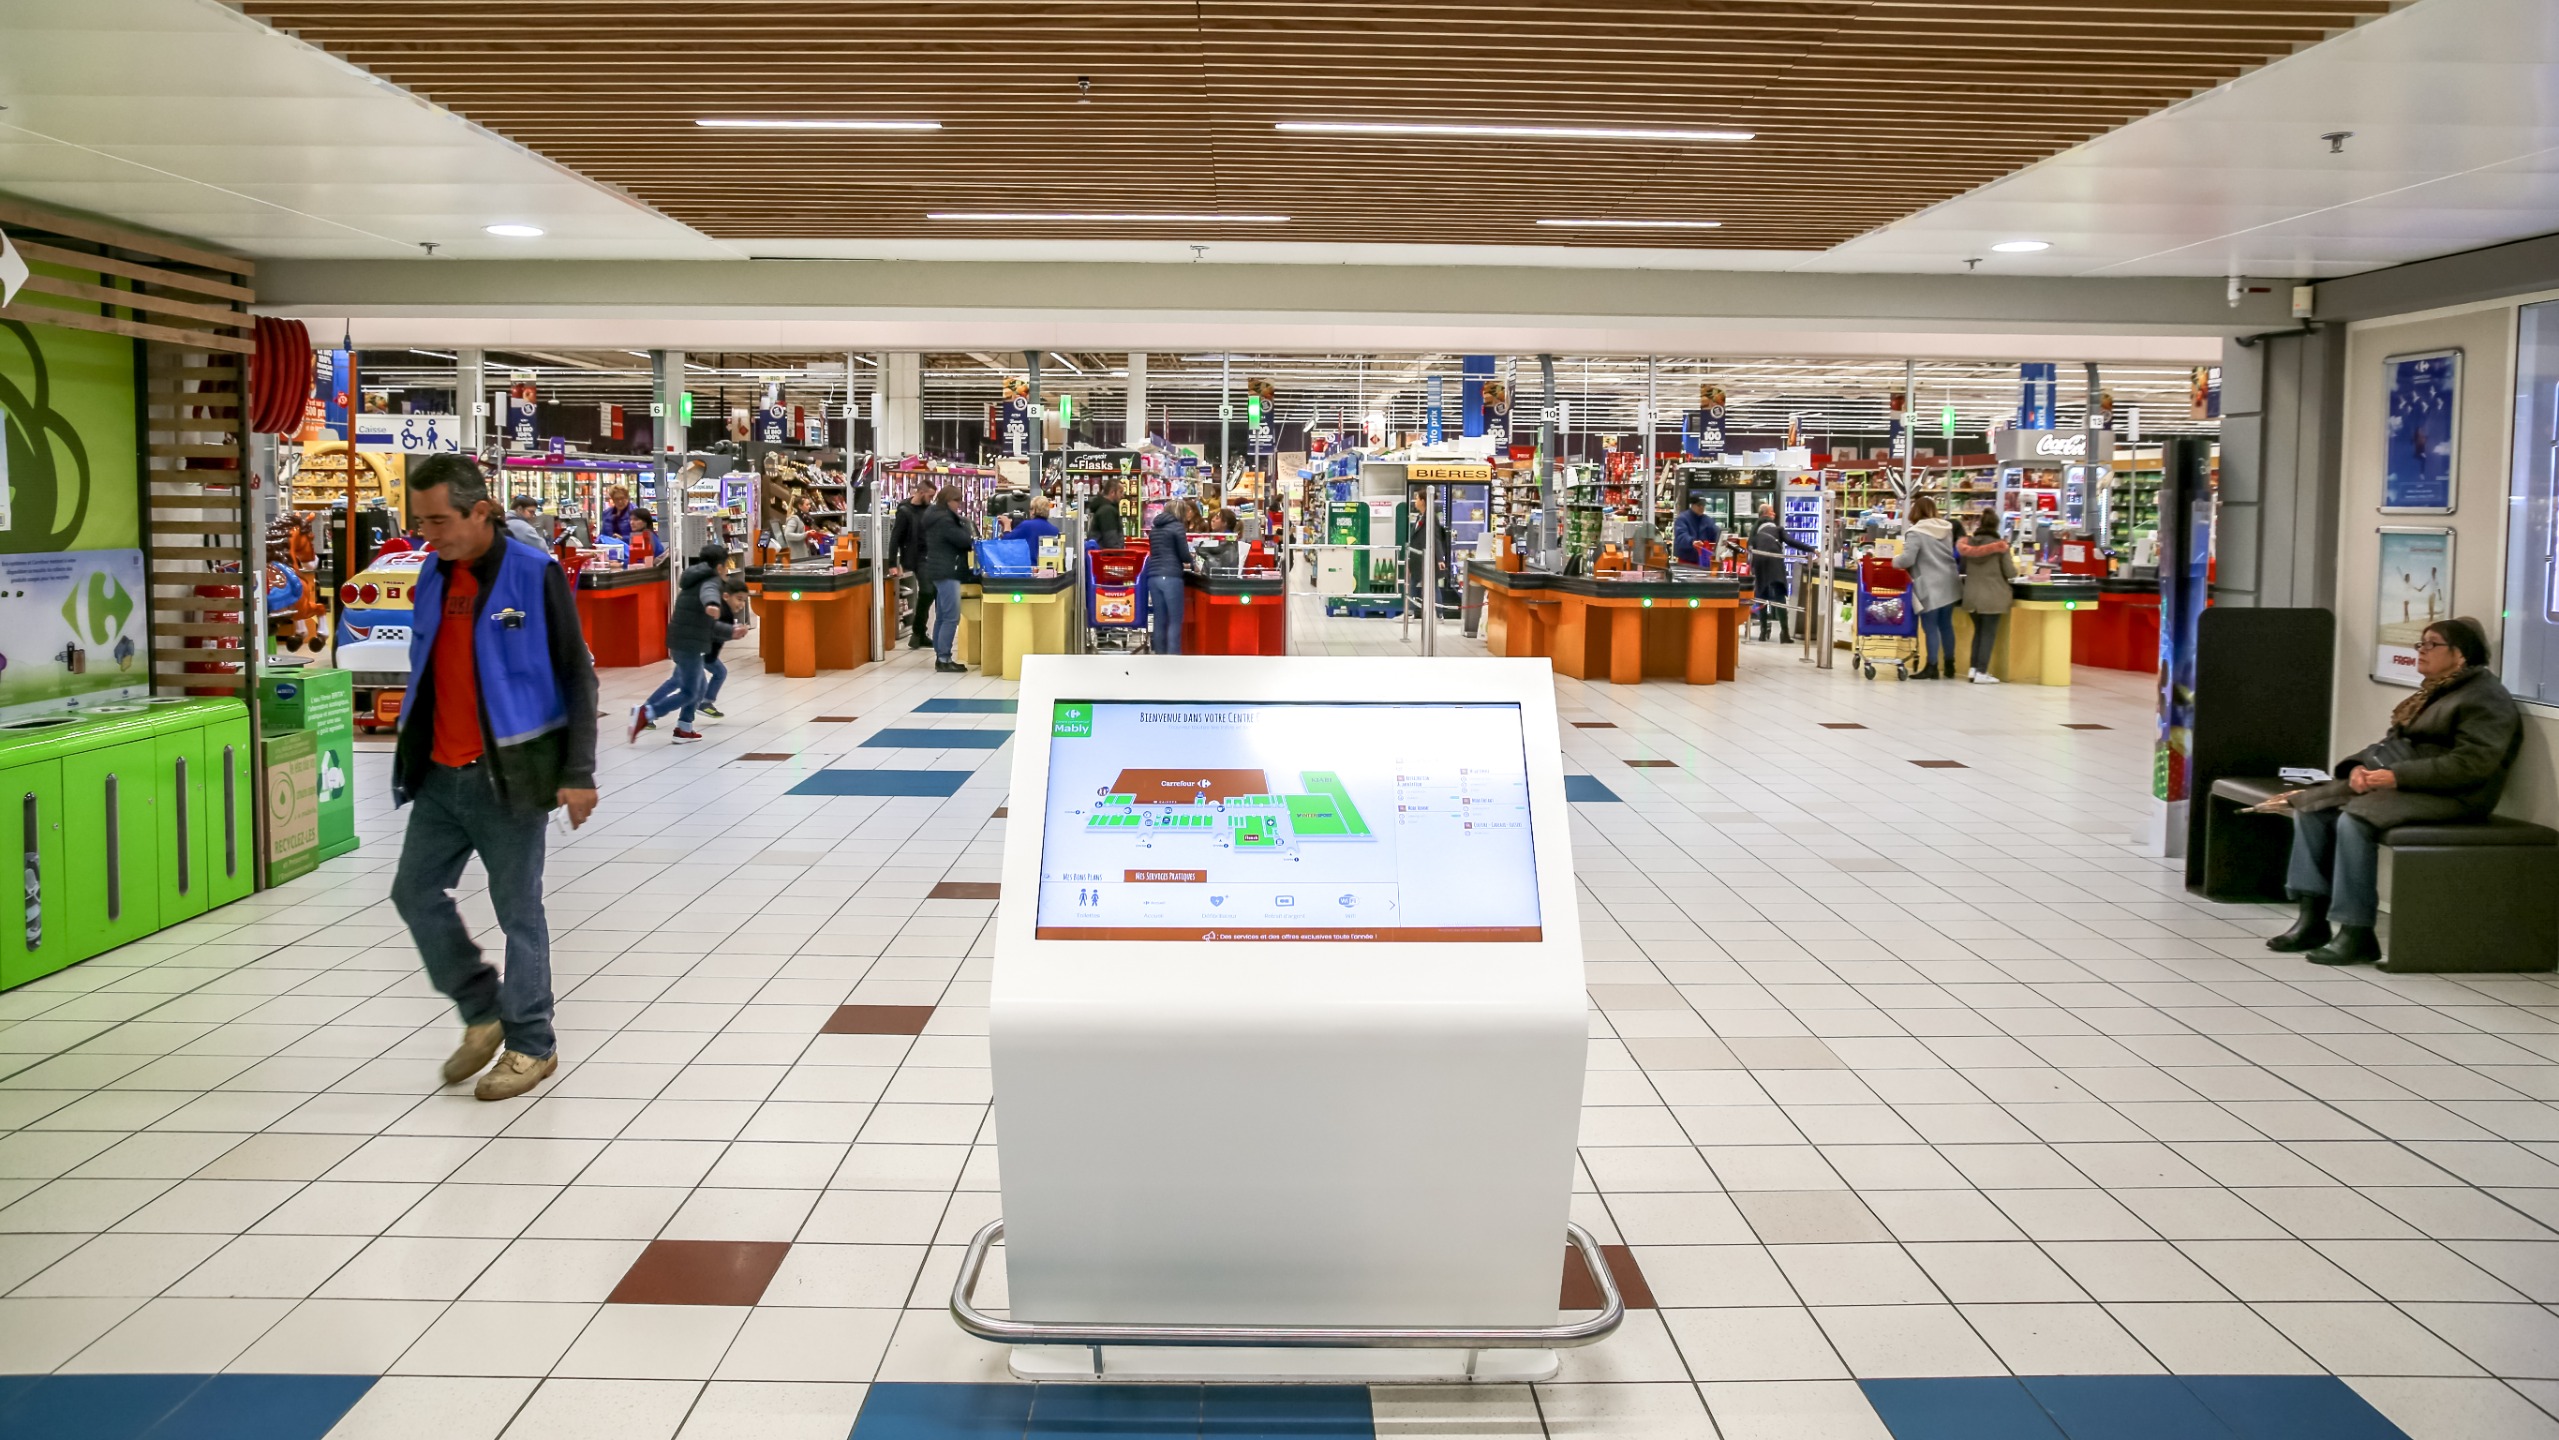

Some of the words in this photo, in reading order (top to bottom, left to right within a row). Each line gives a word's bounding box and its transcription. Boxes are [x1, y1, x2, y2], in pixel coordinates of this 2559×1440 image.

[476, 404, 482, 413] 5
[654, 405, 660, 414] 6
[1430, 410, 1439, 427] prix
[1544, 410, 1555, 418] 10
[358, 425, 387, 433] Caisse
[1007, 424, 1025, 432] 100
[1704, 432, 1721, 440] 100
[1079, 460, 1113, 470] Flasks
[1416, 468, 1487, 478] BIÈRES
[2393, 655, 2416, 666] FRAM
[1140, 712, 1182, 723] BIENVENUE
[1183, 712, 1202, 723] DANS
[1204, 712, 1226, 723] VOTRE
[1055, 724, 1089, 735] Mably
[274, 827, 315, 854] RECYCLEZ-LES
[1169, 872, 1196, 882] PRATIQUES
